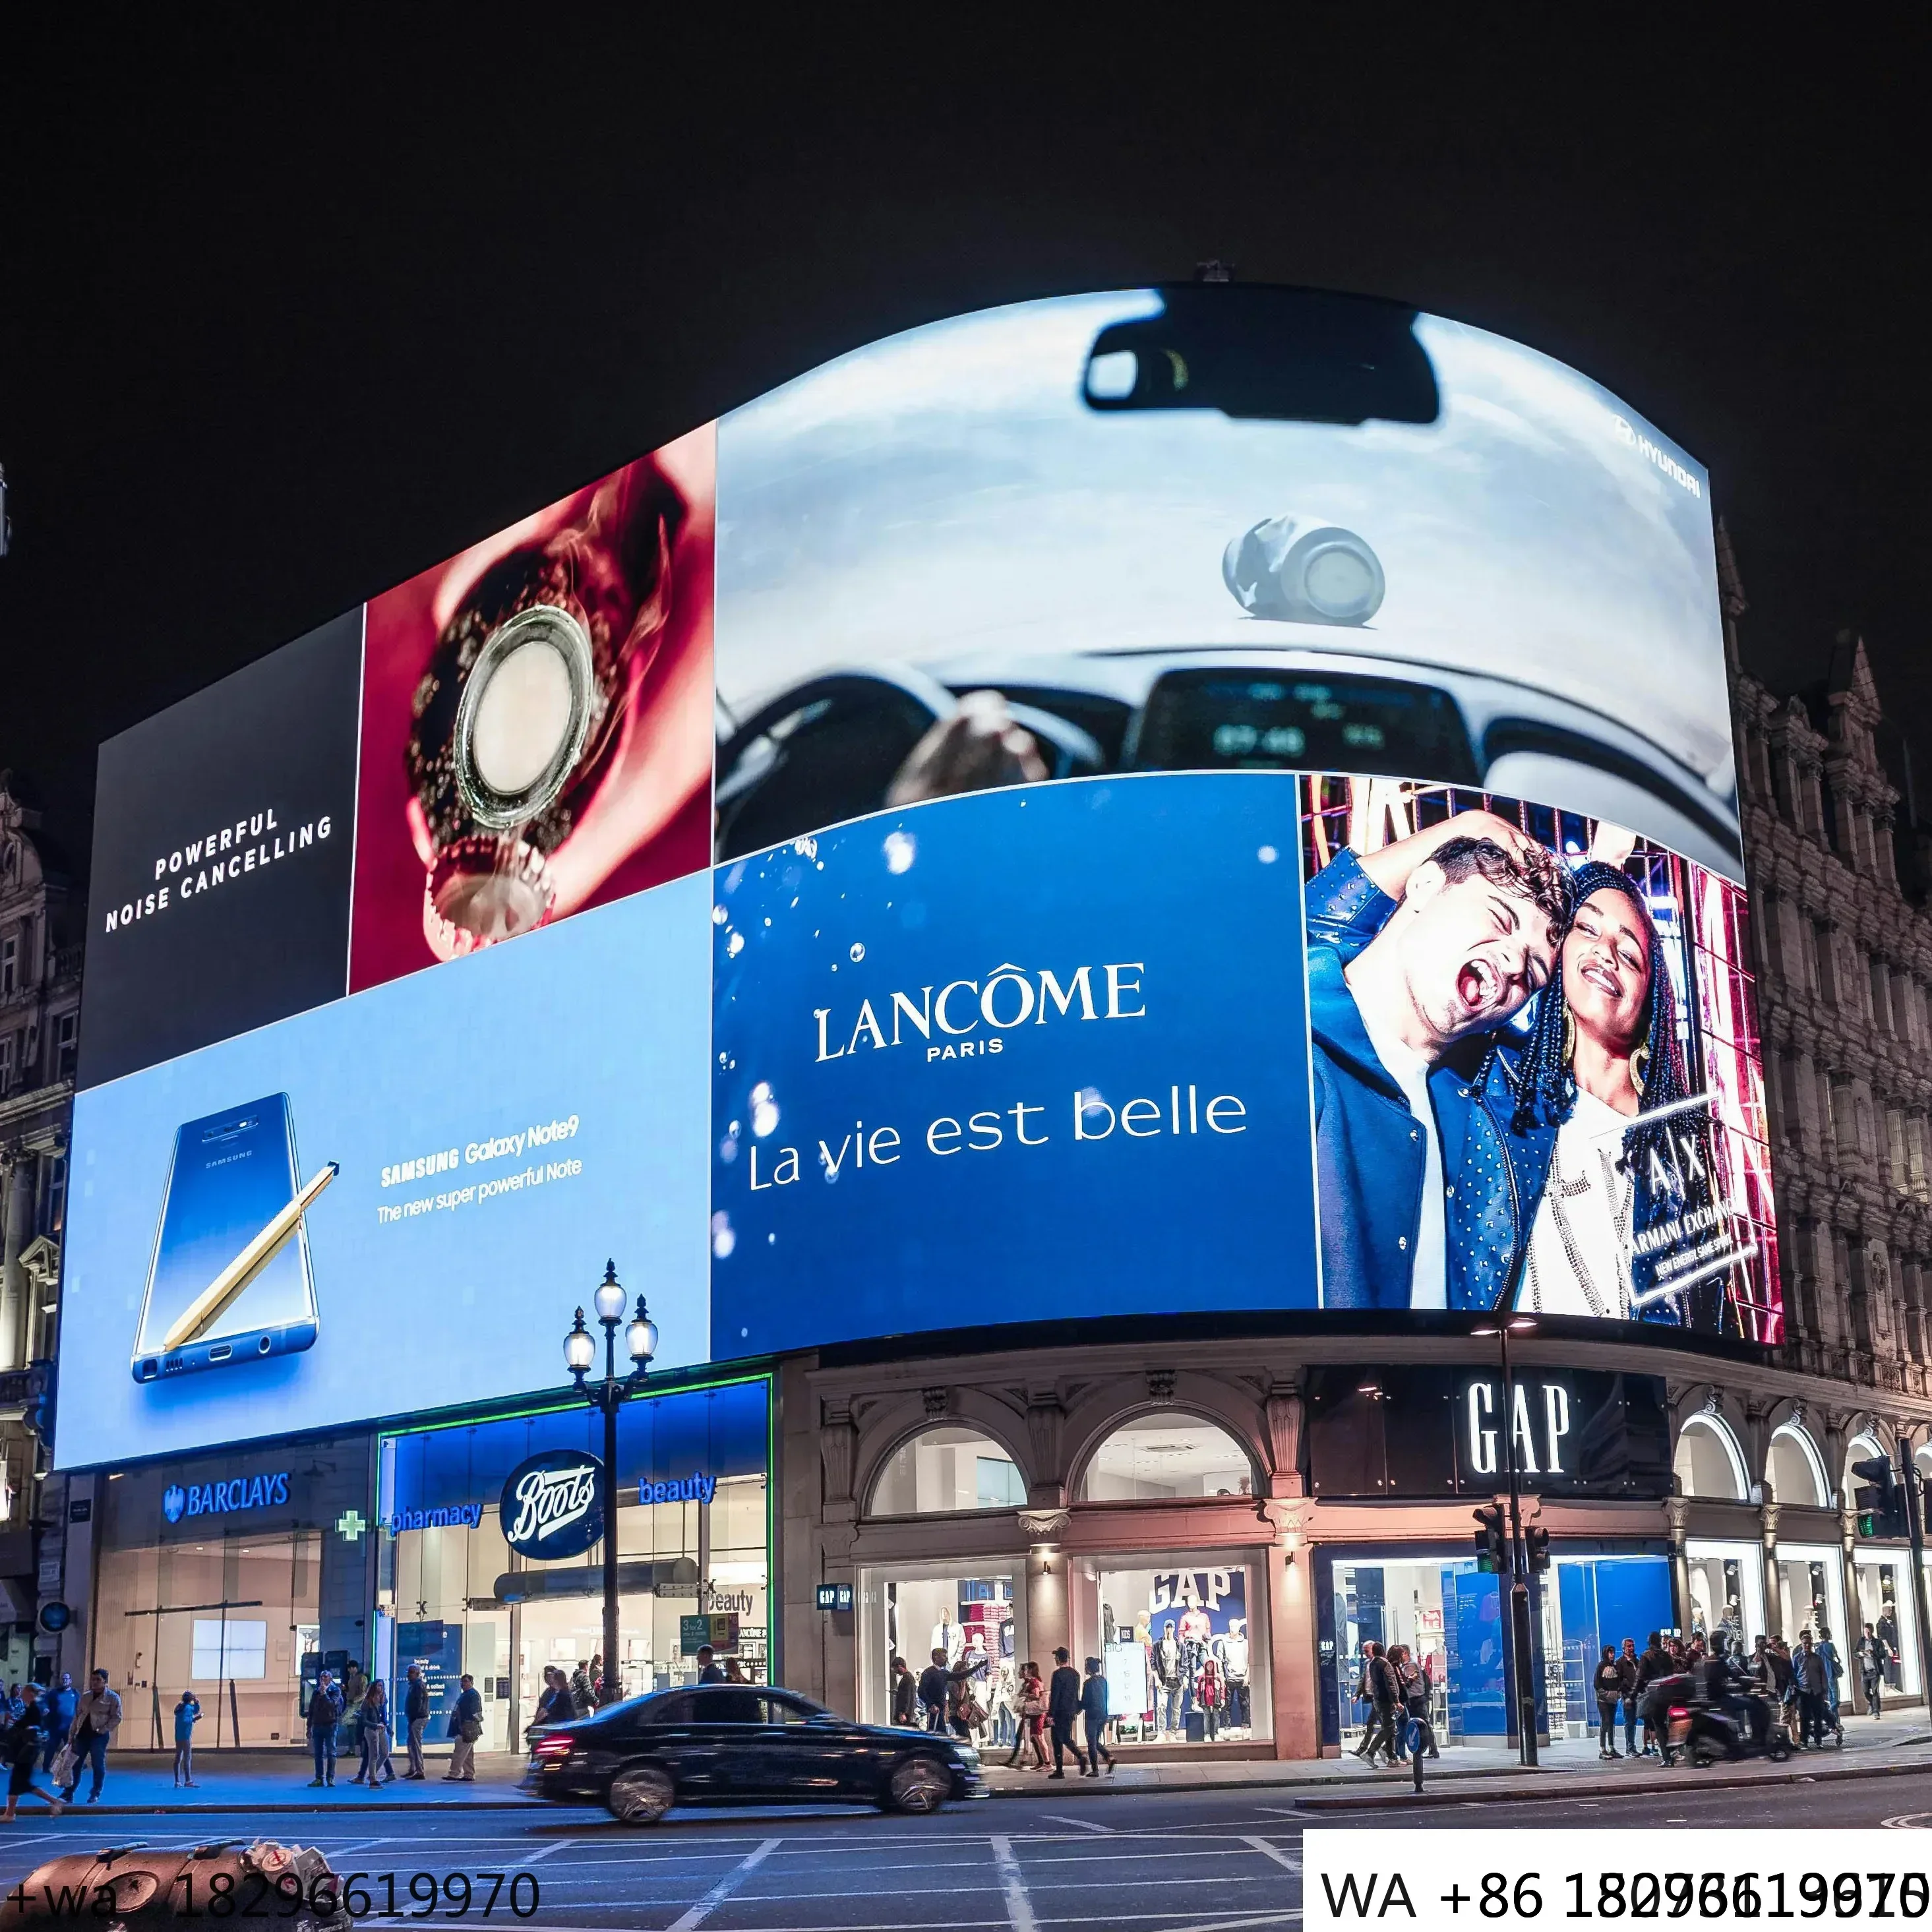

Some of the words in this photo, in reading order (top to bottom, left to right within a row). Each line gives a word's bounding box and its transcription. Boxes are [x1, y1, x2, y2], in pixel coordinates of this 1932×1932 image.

[1638, 435, 1701, 498] HYUNDAI
[105, 887, 169, 933] NOISE
[180, 816, 331, 899] CANCELLING
[155, 808, 278, 880] POWERFUL
[815, 962, 1147, 1062] LANCÔME
[927, 1038, 1004, 1062] PARIS
[205, 1150, 253, 1169] SAMSUNG
[380, 1147, 460, 1188] SAMSUNG
[464, 1132, 526, 1164] Galaxy
[528, 1114, 580, 1148] Note9
[749, 1145, 800, 1192] La
[819, 1120, 901, 1174] vie
[926, 1101, 1049, 1156] est
[1073, 1085, 1248, 1141] belle
[377, 1205, 403, 1224] The
[403, 1196, 435, 1219] new
[436, 1185, 477, 1211] super
[477, 1164, 545, 1205] powerful
[546, 1158, 583, 1182] Note
[1468, 1383, 1569, 1474] GAP
[187, 1472, 291, 1517] BARCLAYS
[507, 1464, 596, 1542] Boots
[638, 1470, 717, 1505] beauty
[390, 1503, 483, 1537] pharmacy
[820, 1590, 835, 1604] GAP
[1149, 1571, 1231, 1615] GAP
[682, 1619, 690, 1631] 3
[696, 1619, 704, 1630] 2
